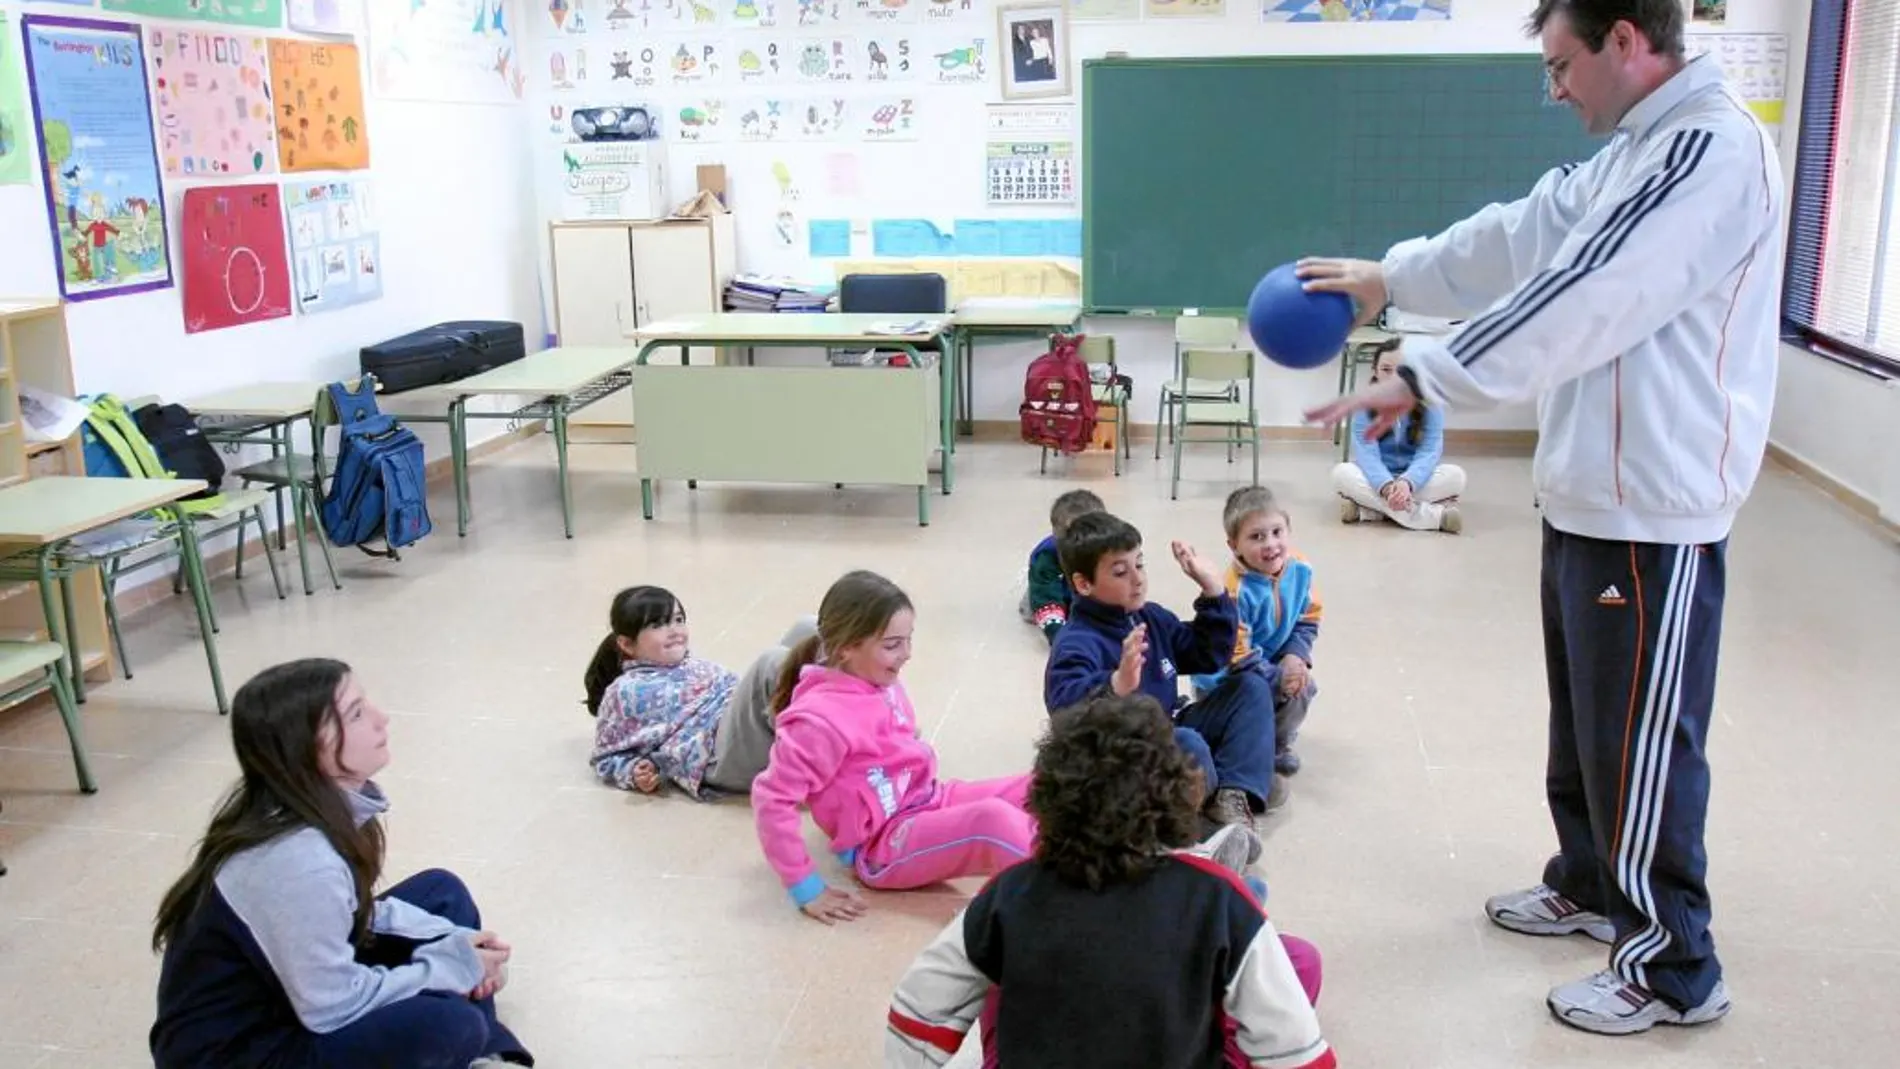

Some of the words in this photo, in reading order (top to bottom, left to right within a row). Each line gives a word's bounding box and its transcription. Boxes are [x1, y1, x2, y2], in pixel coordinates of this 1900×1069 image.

[641, 48, 654, 63] O
[703, 45, 715, 62] P
[899, 39, 910, 56] S
[550, 105, 563, 121] U
[766, 100, 781, 117] X
[833, 98, 845, 117] Y
[901, 99, 913, 115] Z
